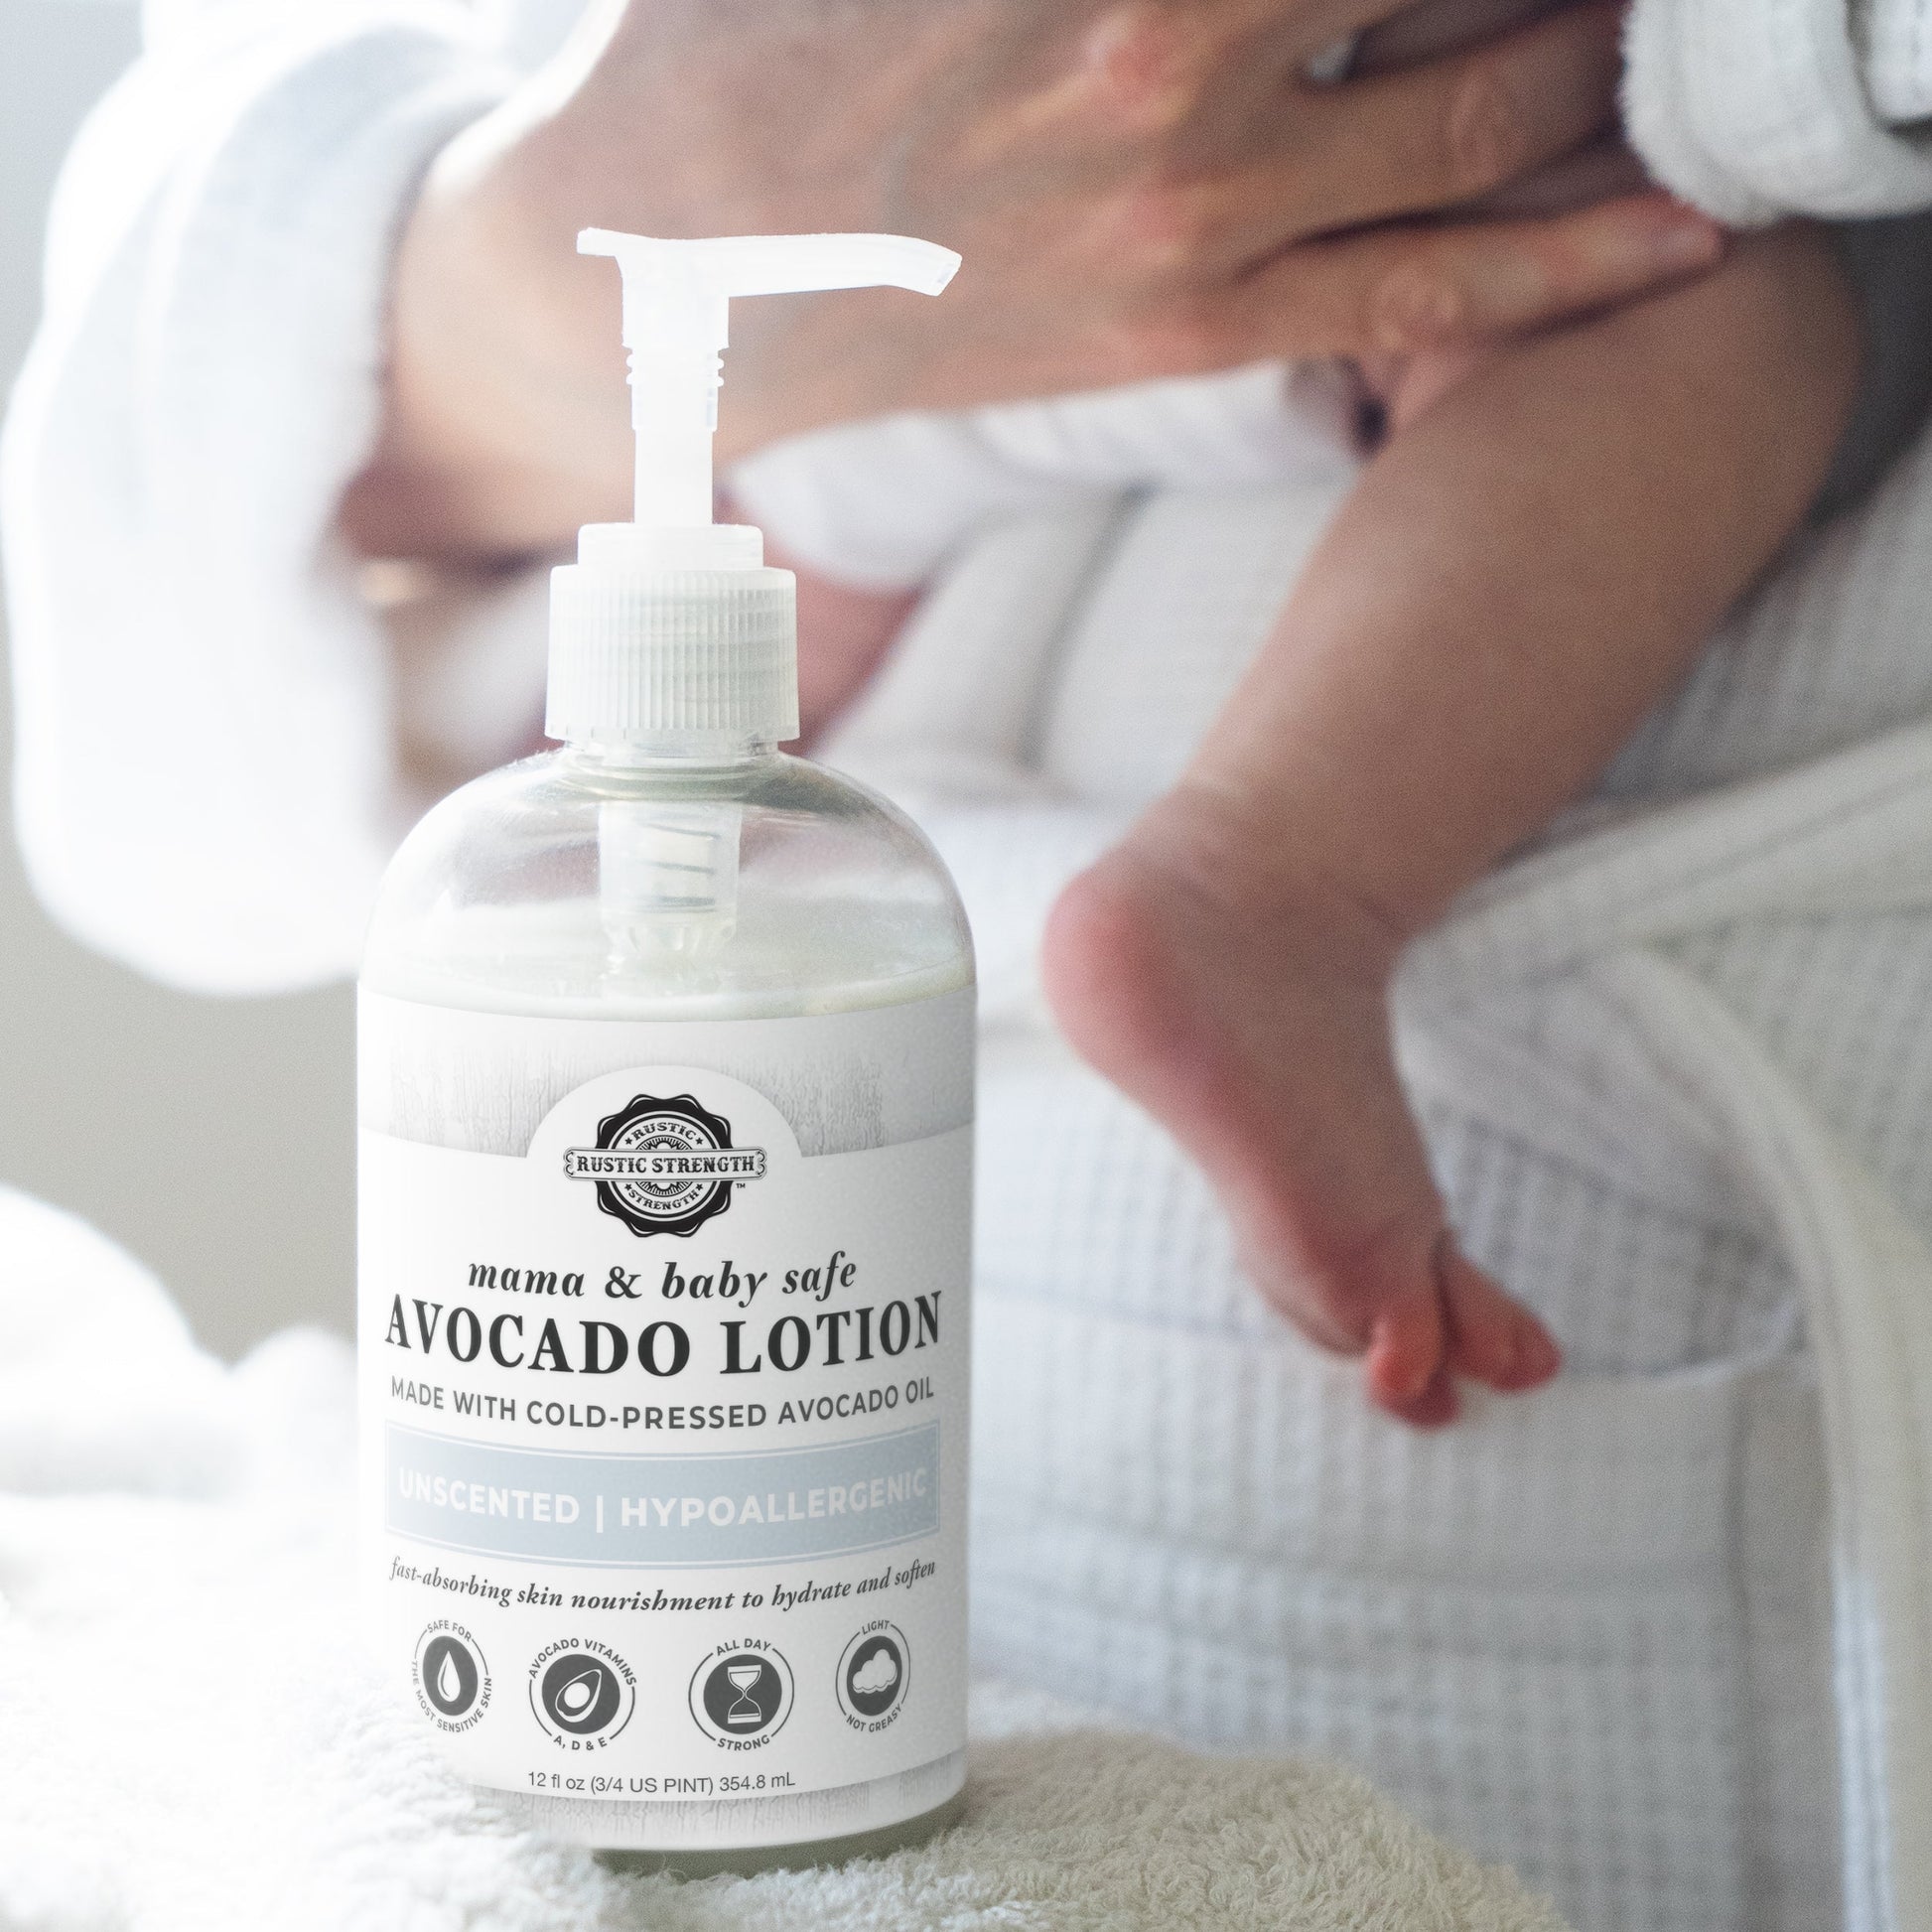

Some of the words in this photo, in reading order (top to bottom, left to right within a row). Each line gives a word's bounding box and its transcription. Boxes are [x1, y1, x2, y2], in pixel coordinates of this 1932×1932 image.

[630, 1122, 697, 1141] RUSTIC
[577, 1156, 647, 1173] RUSTIC
[651, 1156, 755, 1173] STRENGTH
[628, 1189, 699, 1210] STRENGTH
[469, 1263, 585, 1297] mama
[605, 1266, 642, 1299] &
[661, 1261, 767, 1308] baby
[782, 1250, 856, 1302] safe
[384, 1294, 690, 1377] AVOCADO
[720, 1291, 942, 1374] LOTION
[391, 1375, 444, 1410] MADE
[453, 1390, 516, 1421] WITH
[526, 1401, 766, 1430] COLD-PRESSED
[777, 1385, 898, 1424] AVOCADO
[905, 1376, 934, 1403] OIL
[398, 1467, 580, 1524] UNSCENTED
[621, 1467, 927, 1527] HYPOALLERGENIC
[389, 1556, 512, 1607] fast-absorbing
[516, 1584, 562, 1606] skin
[571, 1588, 735, 1611] nourishment
[742, 1591, 763, 1608] to
[771, 1581, 851, 1611] hydrate
[857, 1566, 891, 1594] and
[895, 1558, 935, 1588] soften
[427, 1619, 450, 1633] SAFE
[452, 1622, 472, 1641] FOR
[862, 1619, 890, 1635] LIGHT
[717, 1640, 740, 1656] ALL
[745, 1638, 771, 1652] DAY
[528, 1638, 580, 1679] AVOCADO
[584, 1639, 637, 1686] VITAMINS
[415, 1690, 436, 1722] MOST
[437, 1710, 483, 1732] SENSITIVE
[481, 1677, 491, 1709] SKIN
[846, 1714, 866, 1732] NOT
[869, 1703, 903, 1732] GREASY
[554, 1735, 566, 1749] A,
[571, 1740, 581, 1750] D
[586, 1740, 595, 1751] &
[598, 1736, 608, 1747] E
[718, 1734, 770, 1751] STRONG
[528, 1771, 546, 1787] 12
[551, 1774, 560, 1788] fl
[566, 1778, 585, 1790] oz
[591, 1776, 623, 1795] (3/4
[629, 1778, 657, 1793] US
[664, 1777, 714, 1796] PINT)
[720, 1775, 765, 1791] 354.8
[771, 1772, 795, 1787] mL
